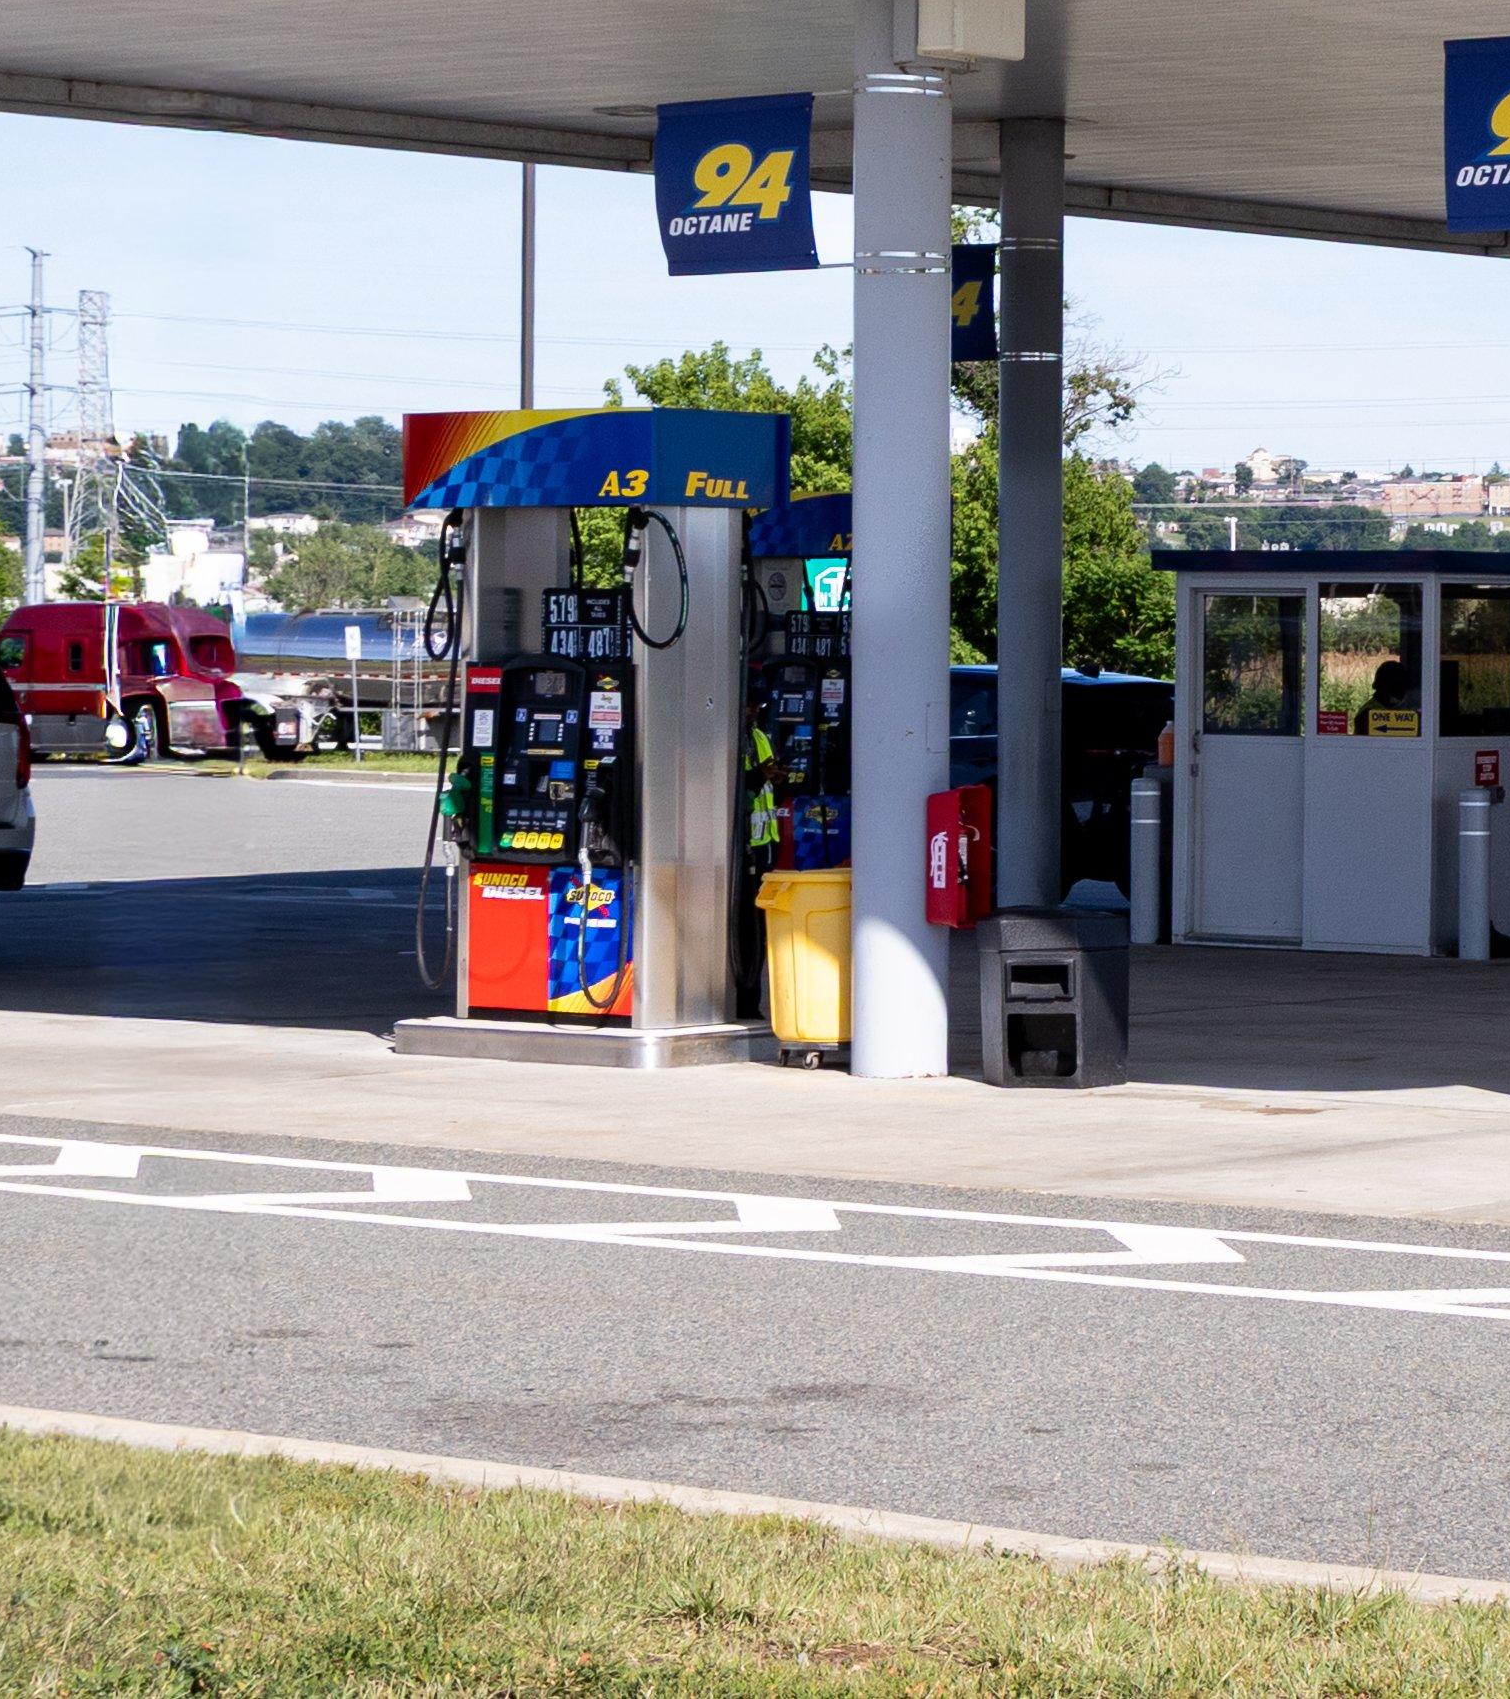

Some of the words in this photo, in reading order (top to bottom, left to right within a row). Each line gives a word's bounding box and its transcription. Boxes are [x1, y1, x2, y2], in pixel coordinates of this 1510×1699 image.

[692, 144, 794, 220] 94
[668, 212, 753, 236] OCTANE
[951, 281, 983, 326] 4
[599, 469, 649, 497] A3
[1371, 712, 1390, 722] ONE
[1395, 713, 1415, 722] WAY
[473, 872, 529, 887] SUNOCO
[570, 890, 614, 902] SUOCO
